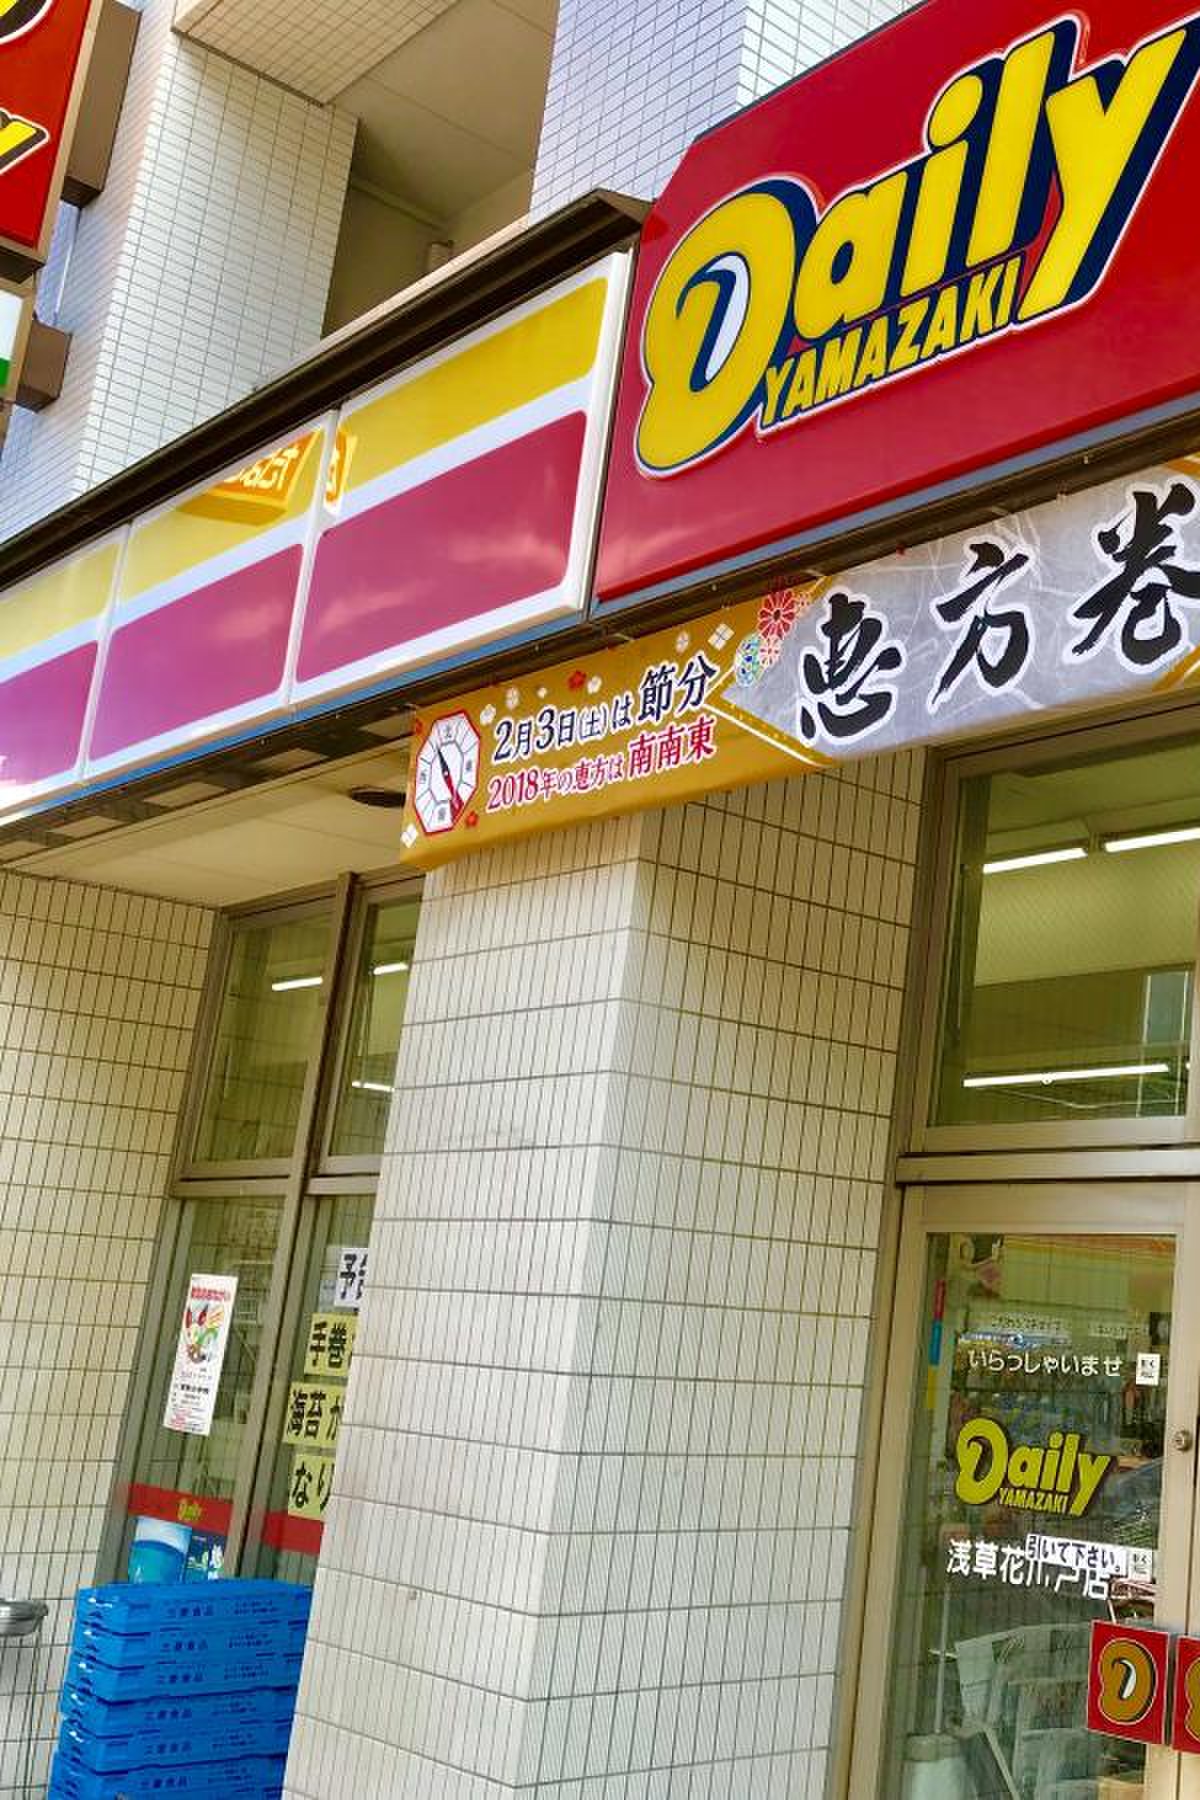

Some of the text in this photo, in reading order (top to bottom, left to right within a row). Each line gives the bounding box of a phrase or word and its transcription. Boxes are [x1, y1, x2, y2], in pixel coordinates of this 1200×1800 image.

[762, 257, 1024, 429] YAMAZAKI
[491, 655, 719, 763] 2月3日(土)は節分
[487, 717, 716, 811] 2018年の恵方は南南東
[968, 1349, 1124, 1376] いらっしゃいませ
[956, 1417, 1111, 1517] Daily
[998, 1486, 1068, 1514] YAMAZAKI
